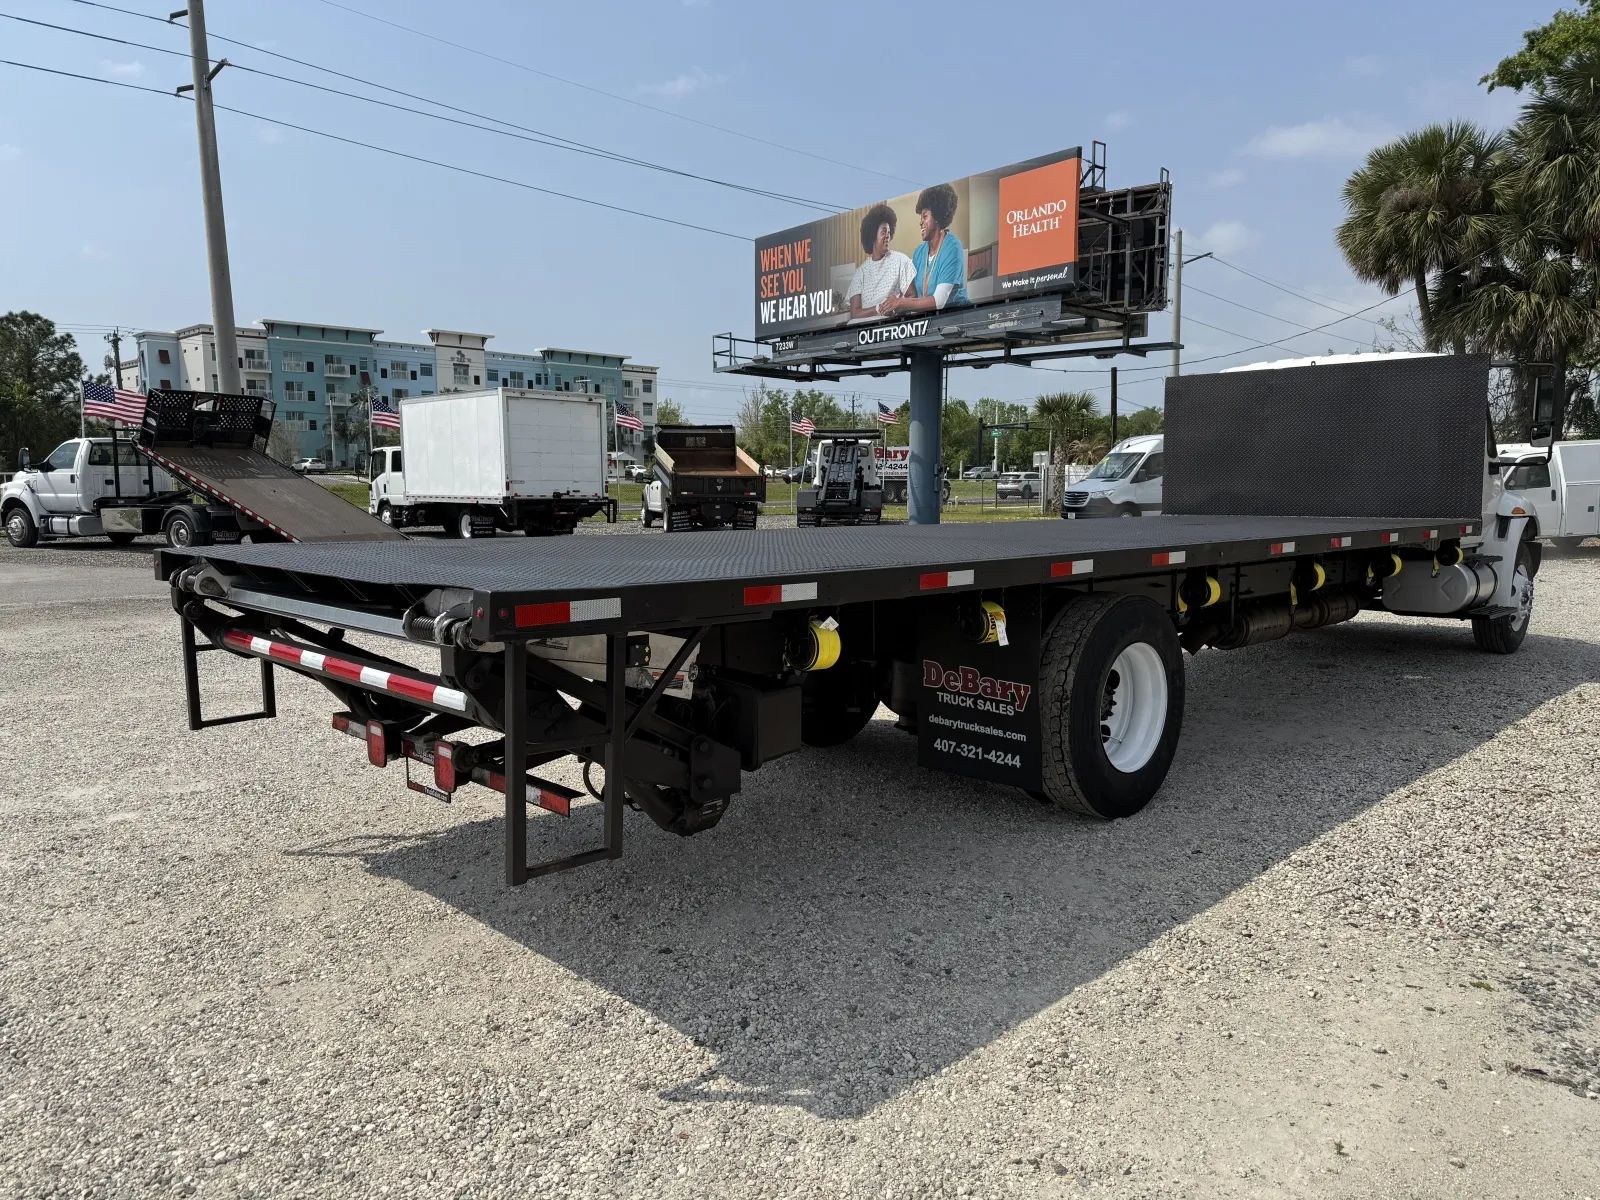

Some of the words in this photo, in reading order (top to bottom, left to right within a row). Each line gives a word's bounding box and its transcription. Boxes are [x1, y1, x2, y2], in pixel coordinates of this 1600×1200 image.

[1006, 199, 1067, 224] ORLANDO
[1013, 216, 1060, 239] HEALTH
[760, 243, 792, 273] WHEN
[794, 238, 812, 265] WE
[760, 274, 780, 299] SEE
[782, 267, 807, 294] YOU,
[1002, 281, 1012, 289] We
[1012, 278, 1029, 287] Make
[1034, 266, 1068, 289] personal
[760, 300, 777, 325] WE
[778, 294, 807, 322] HEAR
[809, 288, 836, 316] YOU.
[874, 447, 910, 461] Bary
[923, 659, 1031, 712] DeBary
[936, 691, 975, 709] TRUCK
[976, 699, 1015, 716] SALES
[928, 714, 1027, 742] debarytrucksales.com
[933, 738, 1022, 768] 407-321-4244
